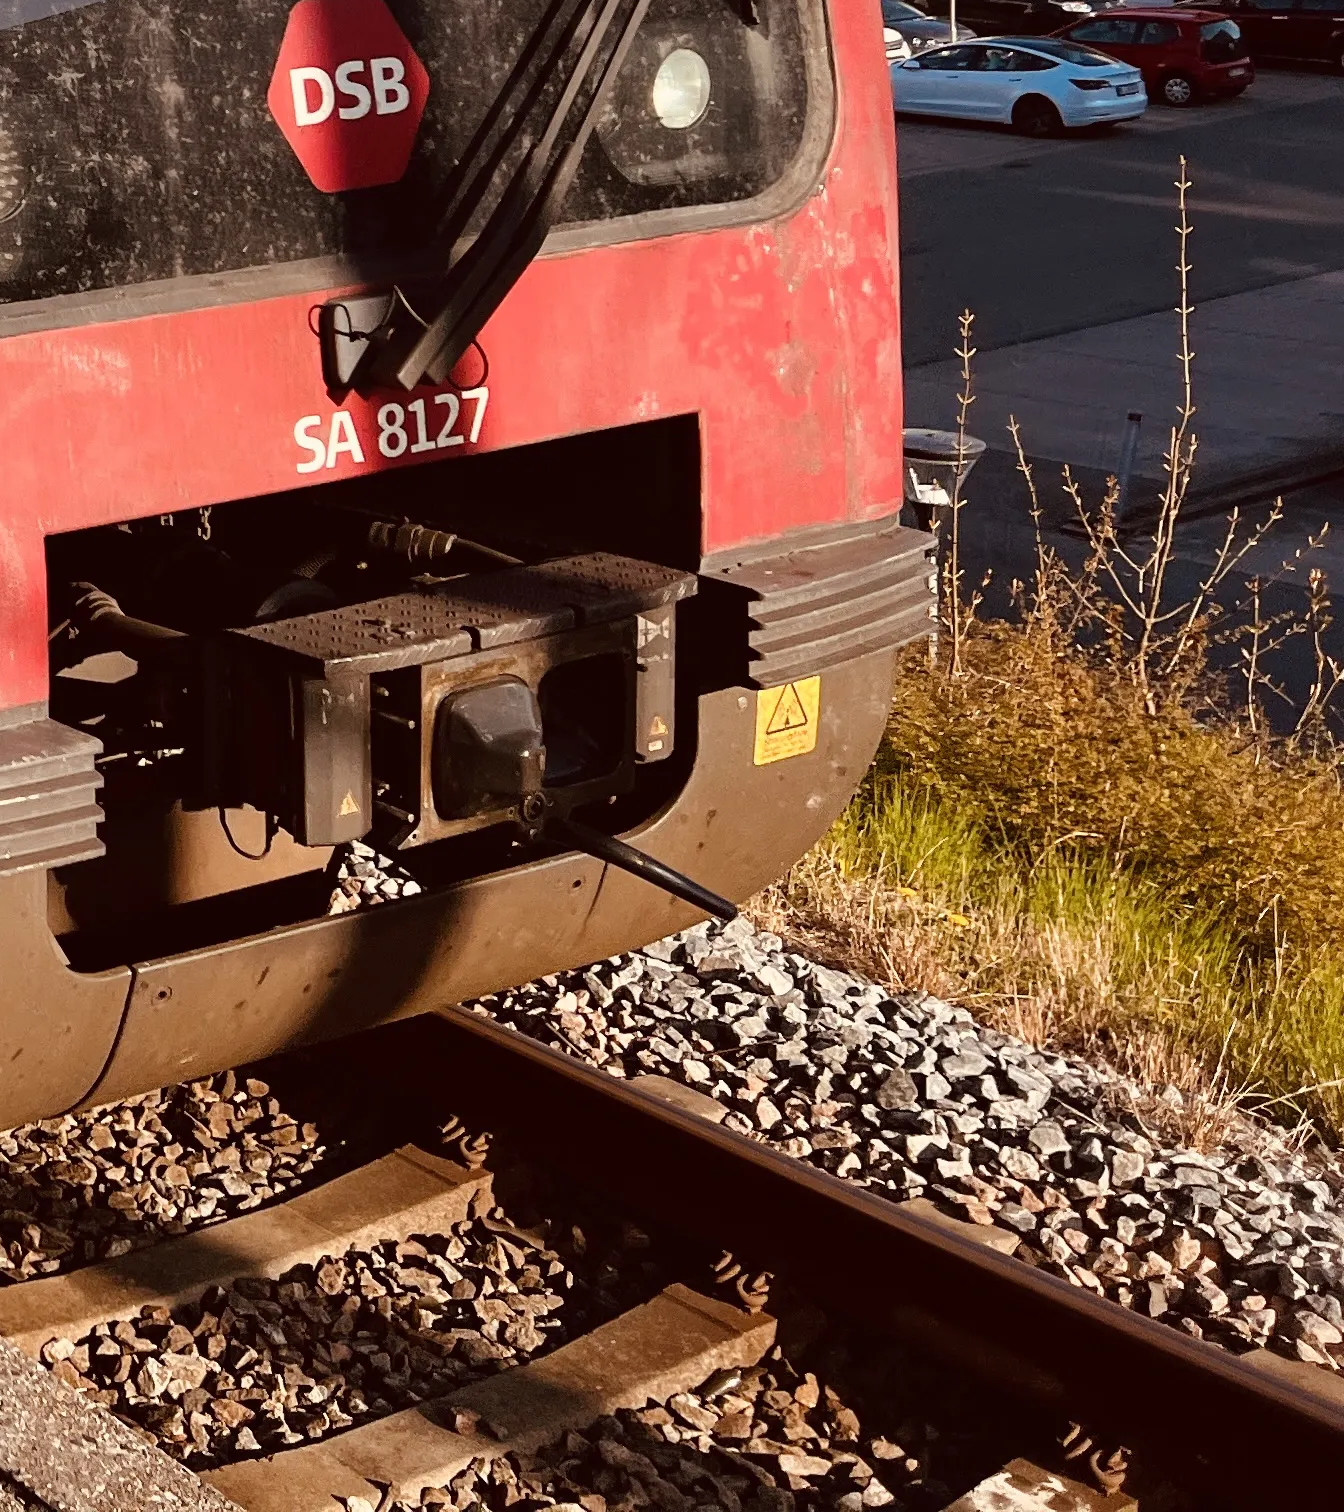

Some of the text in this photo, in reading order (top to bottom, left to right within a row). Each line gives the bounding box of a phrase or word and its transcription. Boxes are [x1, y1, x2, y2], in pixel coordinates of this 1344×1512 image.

[289, 56, 410, 127] DSB
[293, 386, 489, 474] SA 8127
